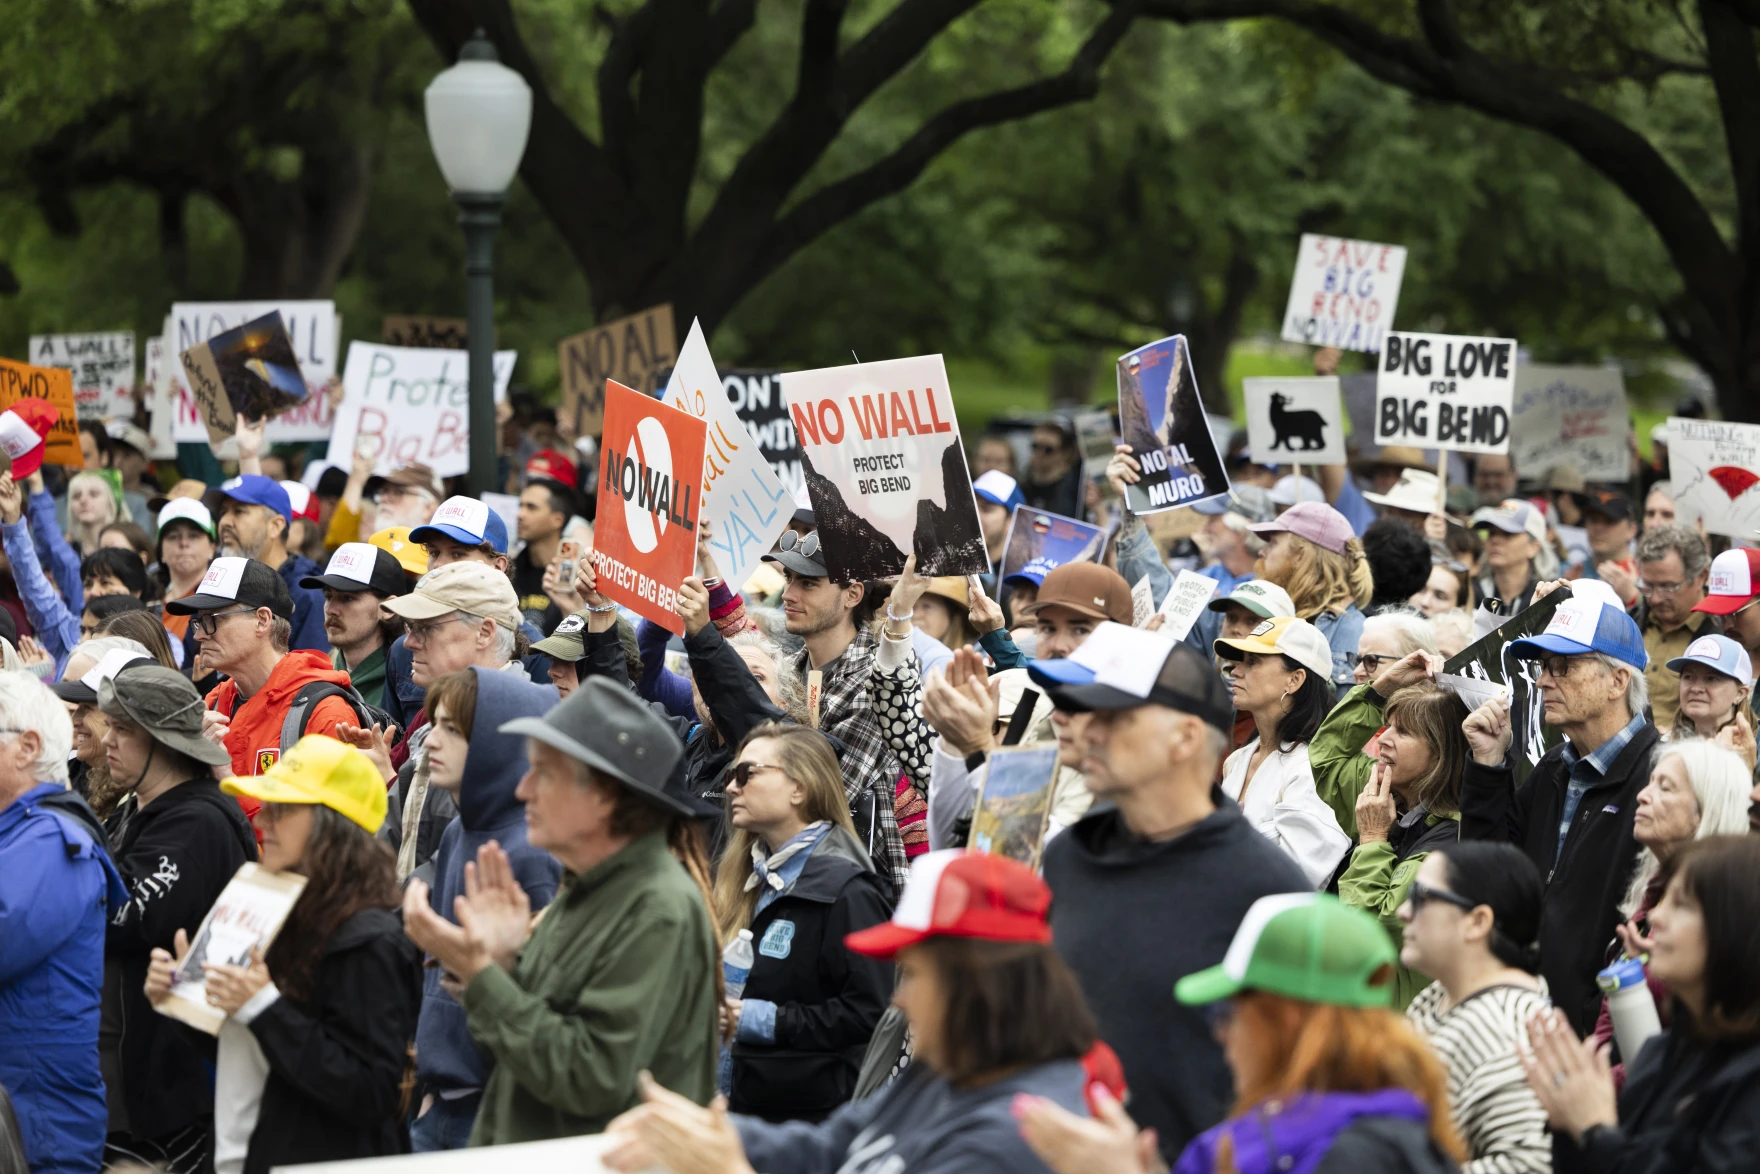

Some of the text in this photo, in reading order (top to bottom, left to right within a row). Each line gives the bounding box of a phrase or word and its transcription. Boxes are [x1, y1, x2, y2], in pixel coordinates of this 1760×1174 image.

[1314, 238, 1393, 272] SAVE
[1323, 265, 1375, 298] BIG
[1310, 292, 1381, 323] BEND
[1292, 316, 1319, 341] NO
[567, 313, 670, 393] NO AL
[1384, 335, 1512, 379] BIG LOVE
[1429, 380, 1457, 395] FOR
[791, 387, 952, 447] NO WALL
[1379, 396, 1428, 437] BIG
[1437, 402, 1510, 446] BEND
[852, 453, 905, 473] PROTECT
[1139, 443, 1195, 475] NO AL
[858, 476, 911, 495] BIG BEND
[1148, 473, 1205, 506] MURO
[710, 467, 785, 576] YA'LL
[594, 549, 684, 618] PROTECT BIG BEN
[1180, 581, 1208, 597] PROTECT
[1169, 604, 1192, 617] LANDS
[1174, 595, 1198, 609] PUBLIC
